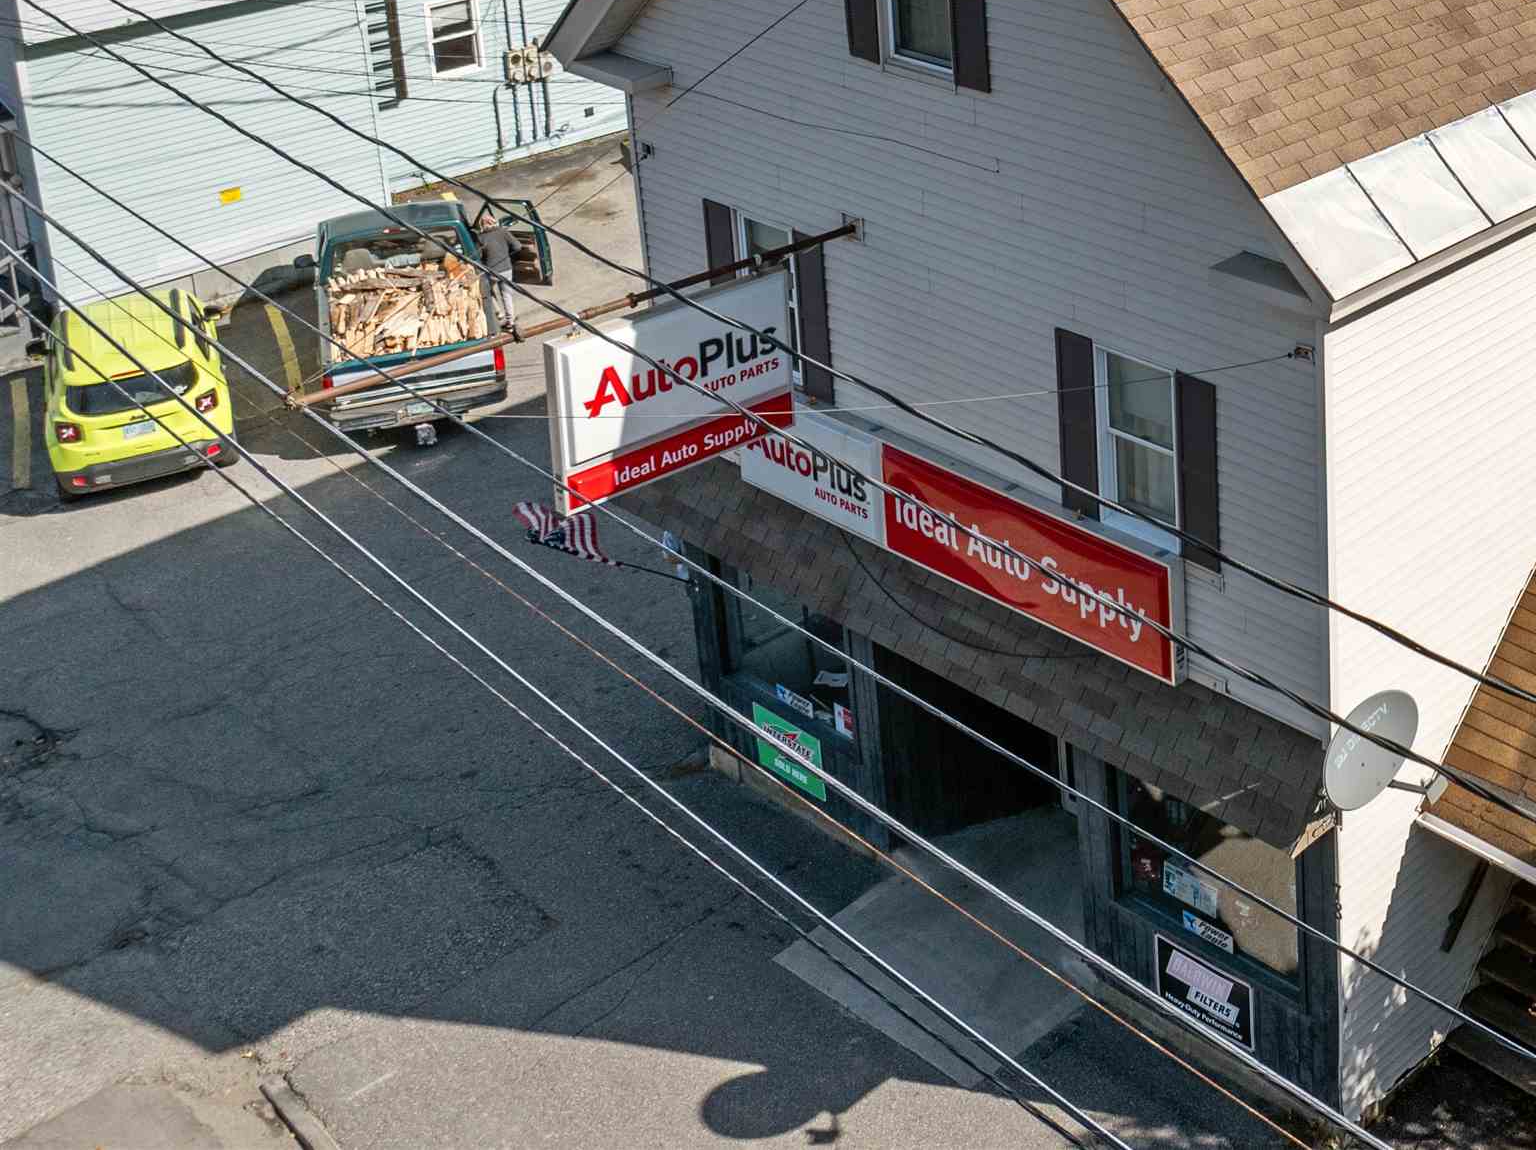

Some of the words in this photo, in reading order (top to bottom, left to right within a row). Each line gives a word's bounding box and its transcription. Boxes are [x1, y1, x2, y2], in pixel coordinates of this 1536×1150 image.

[583, 326, 777, 419] AutoPlus
[703, 373, 737, 392] AUTO
[739, 357, 780, 382] PARTS
[614, 455, 657, 486] Ideal
[660, 443, 698, 468] Auto
[703, 418, 758, 451] Supply
[814, 487, 838, 506] AUTO
[839, 500, 869, 520] PARTS
[893, 493, 959, 550] Ideal
[966, 523, 1031, 581] Auto
[1040, 555, 1146, 643] Supply
[1194, 991, 1233, 1018] FILTERS
